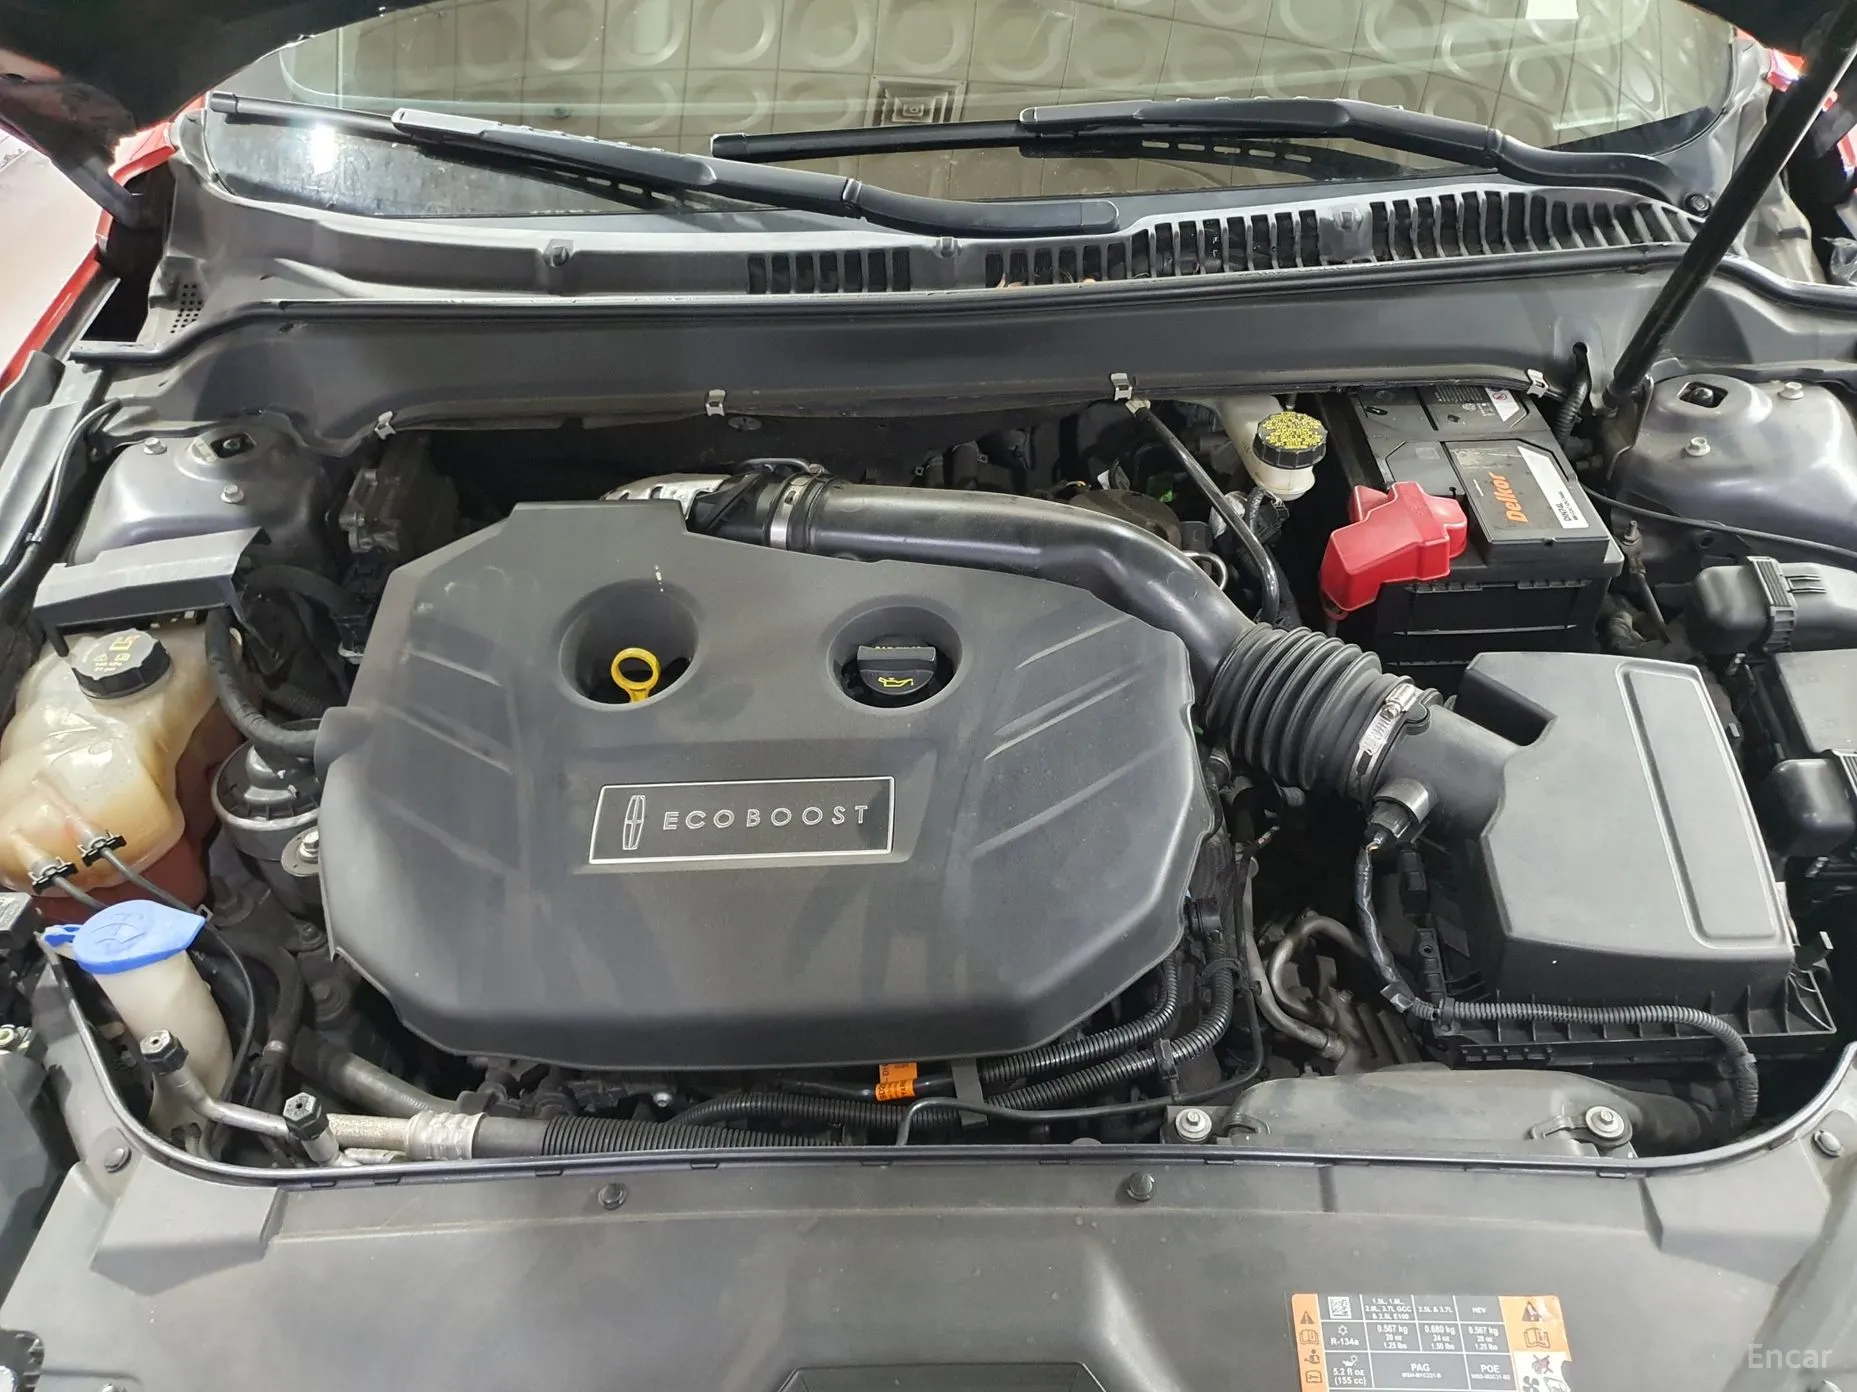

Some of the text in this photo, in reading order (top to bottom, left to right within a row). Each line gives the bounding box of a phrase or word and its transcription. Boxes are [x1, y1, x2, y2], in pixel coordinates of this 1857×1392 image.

[1488, 471, 1529, 524] Delkor
[662, 805, 868, 830] ECOBOOST
[1398, 1324, 1408, 1335] kg
[1445, 1325, 1456, 1336] kg
[1488, 1326, 1499, 1336] kg
[1330, 1337, 1360, 1346] R-134a
[1333, 1368, 1345, 1376] 5.2
[1346, 1368, 1353, 1376] fl
[1410, 1363, 1431, 1372] PAG
[1480, 1364, 1501, 1373] POE
[1334, 1376, 1366, 1386] (155 cc)
